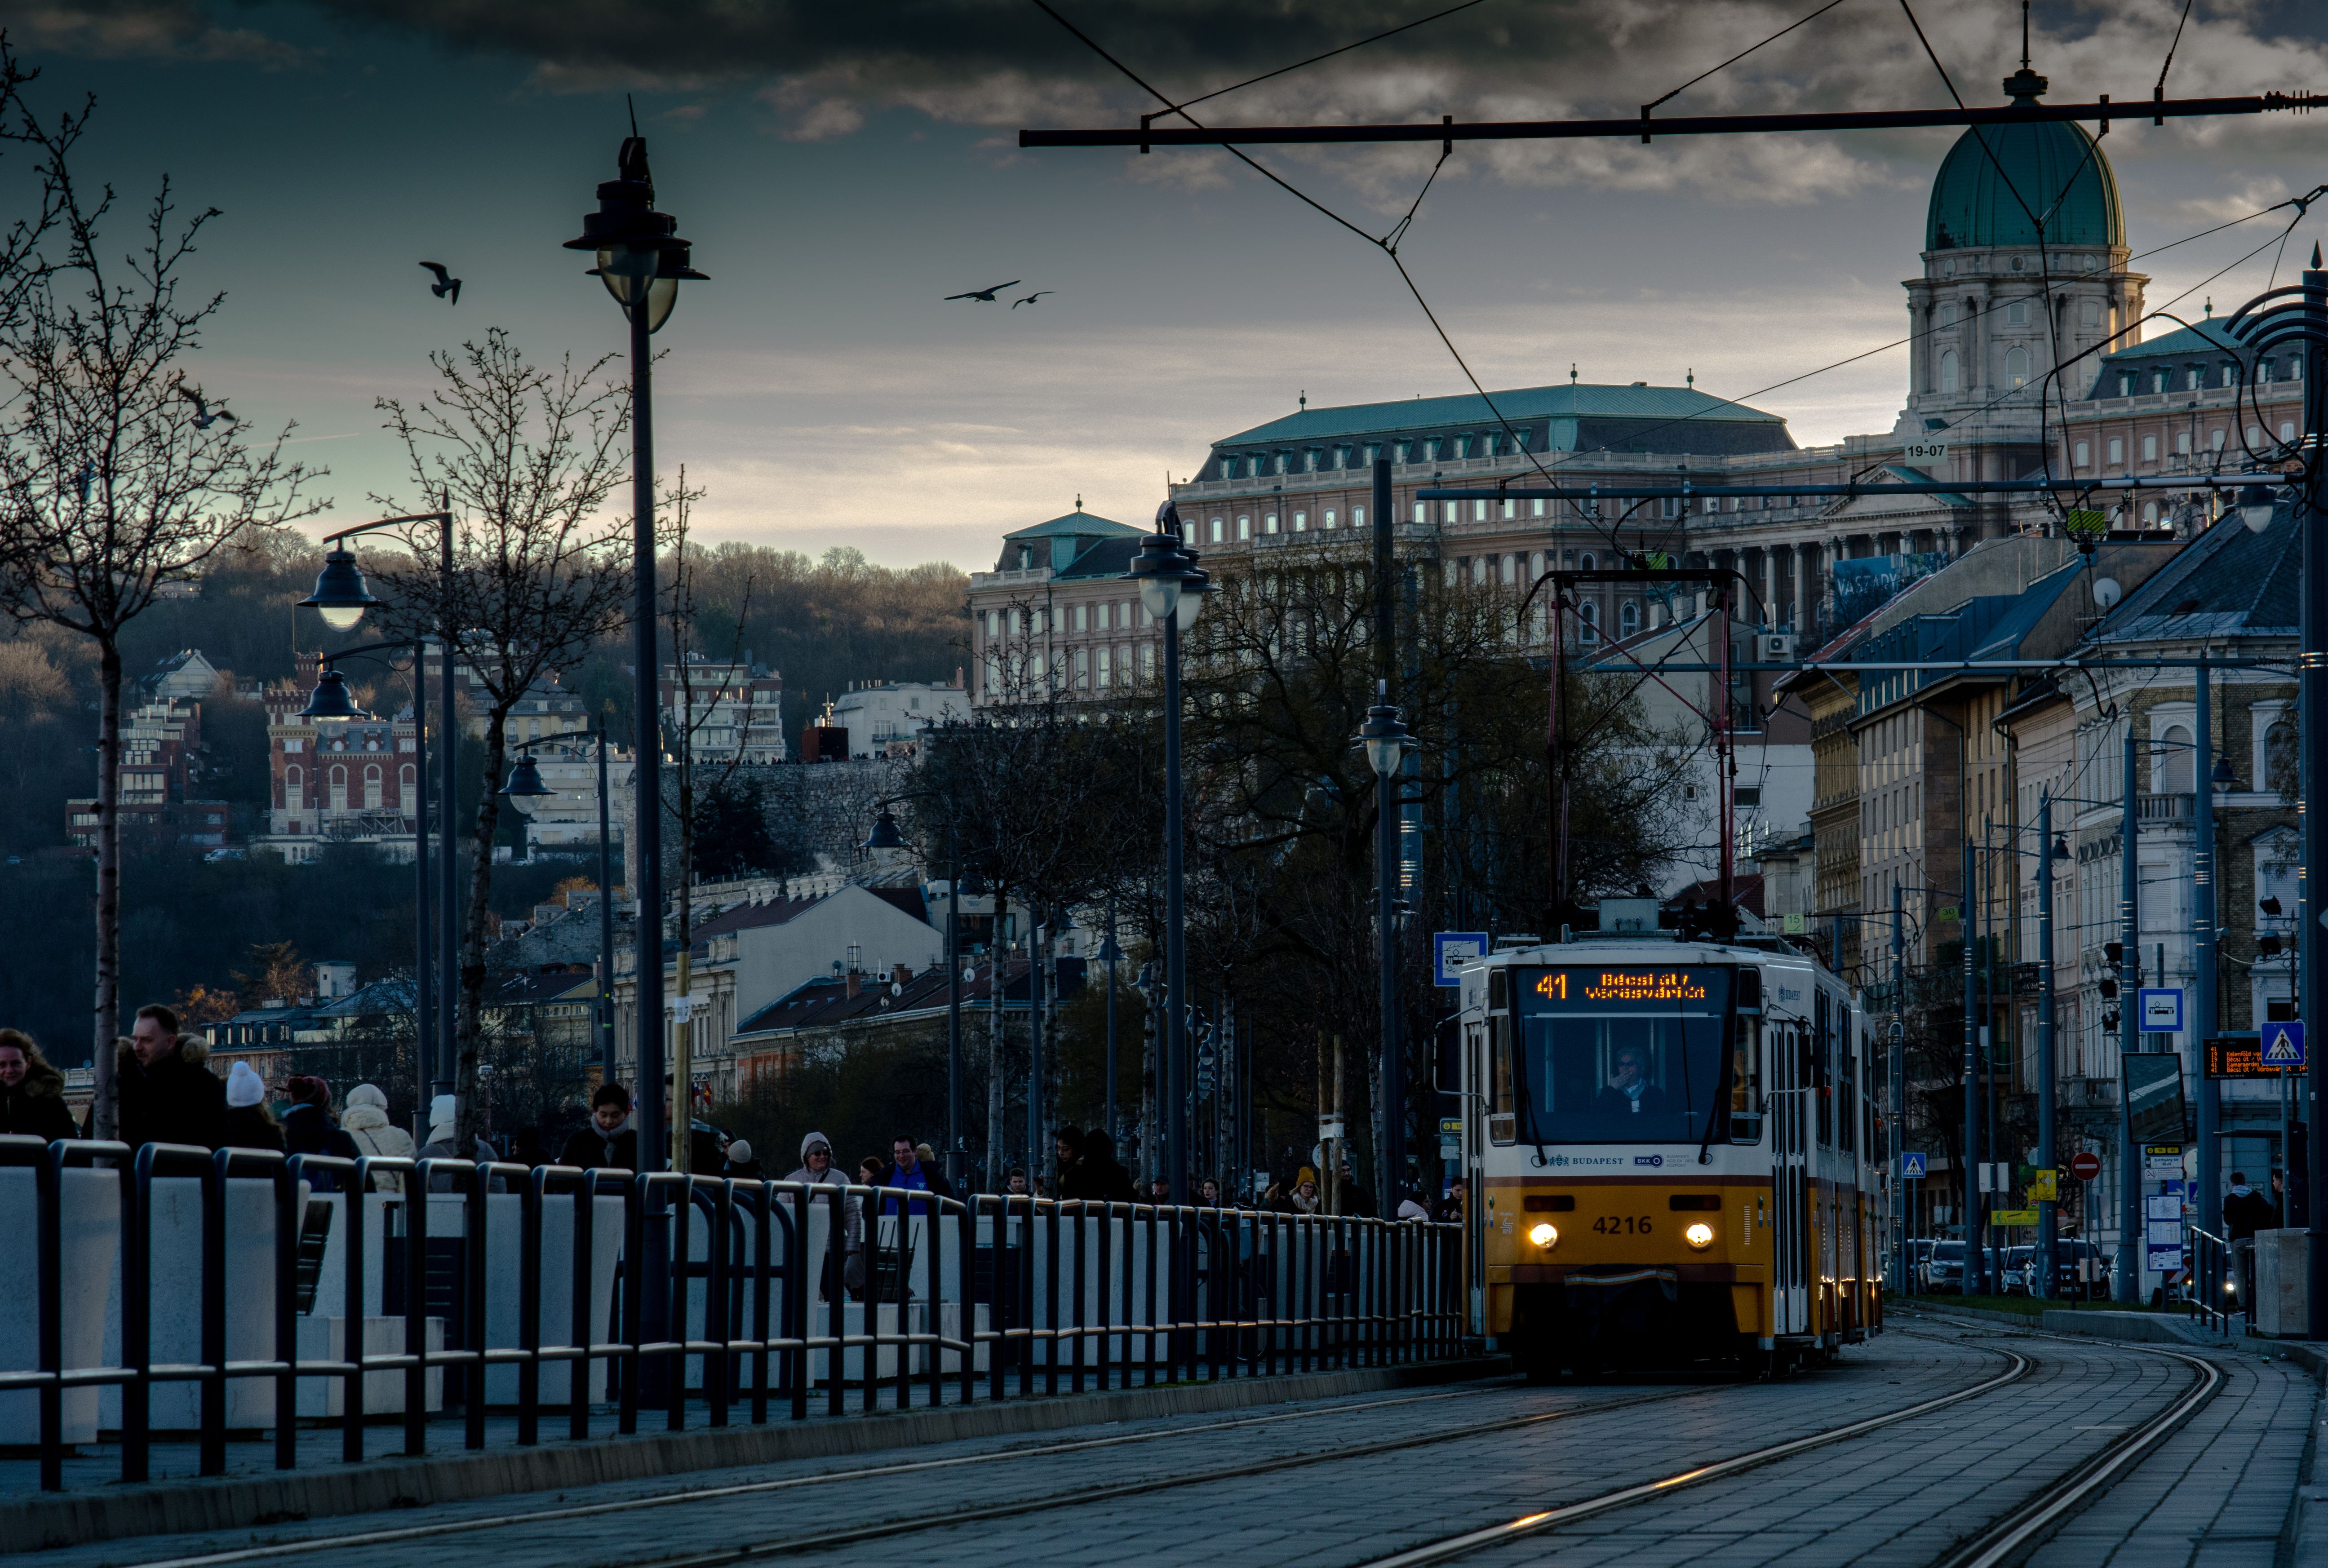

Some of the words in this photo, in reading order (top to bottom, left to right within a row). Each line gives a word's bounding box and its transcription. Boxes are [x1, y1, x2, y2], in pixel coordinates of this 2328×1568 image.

[1908, 445, 1945, 456] 19-07
[1788, 915, 1800, 923] 15
[1602, 974, 1654, 985] Bécsi
[1537, 974, 1566, 999] 41
[1593, 1216, 1652, 1234] 4216
